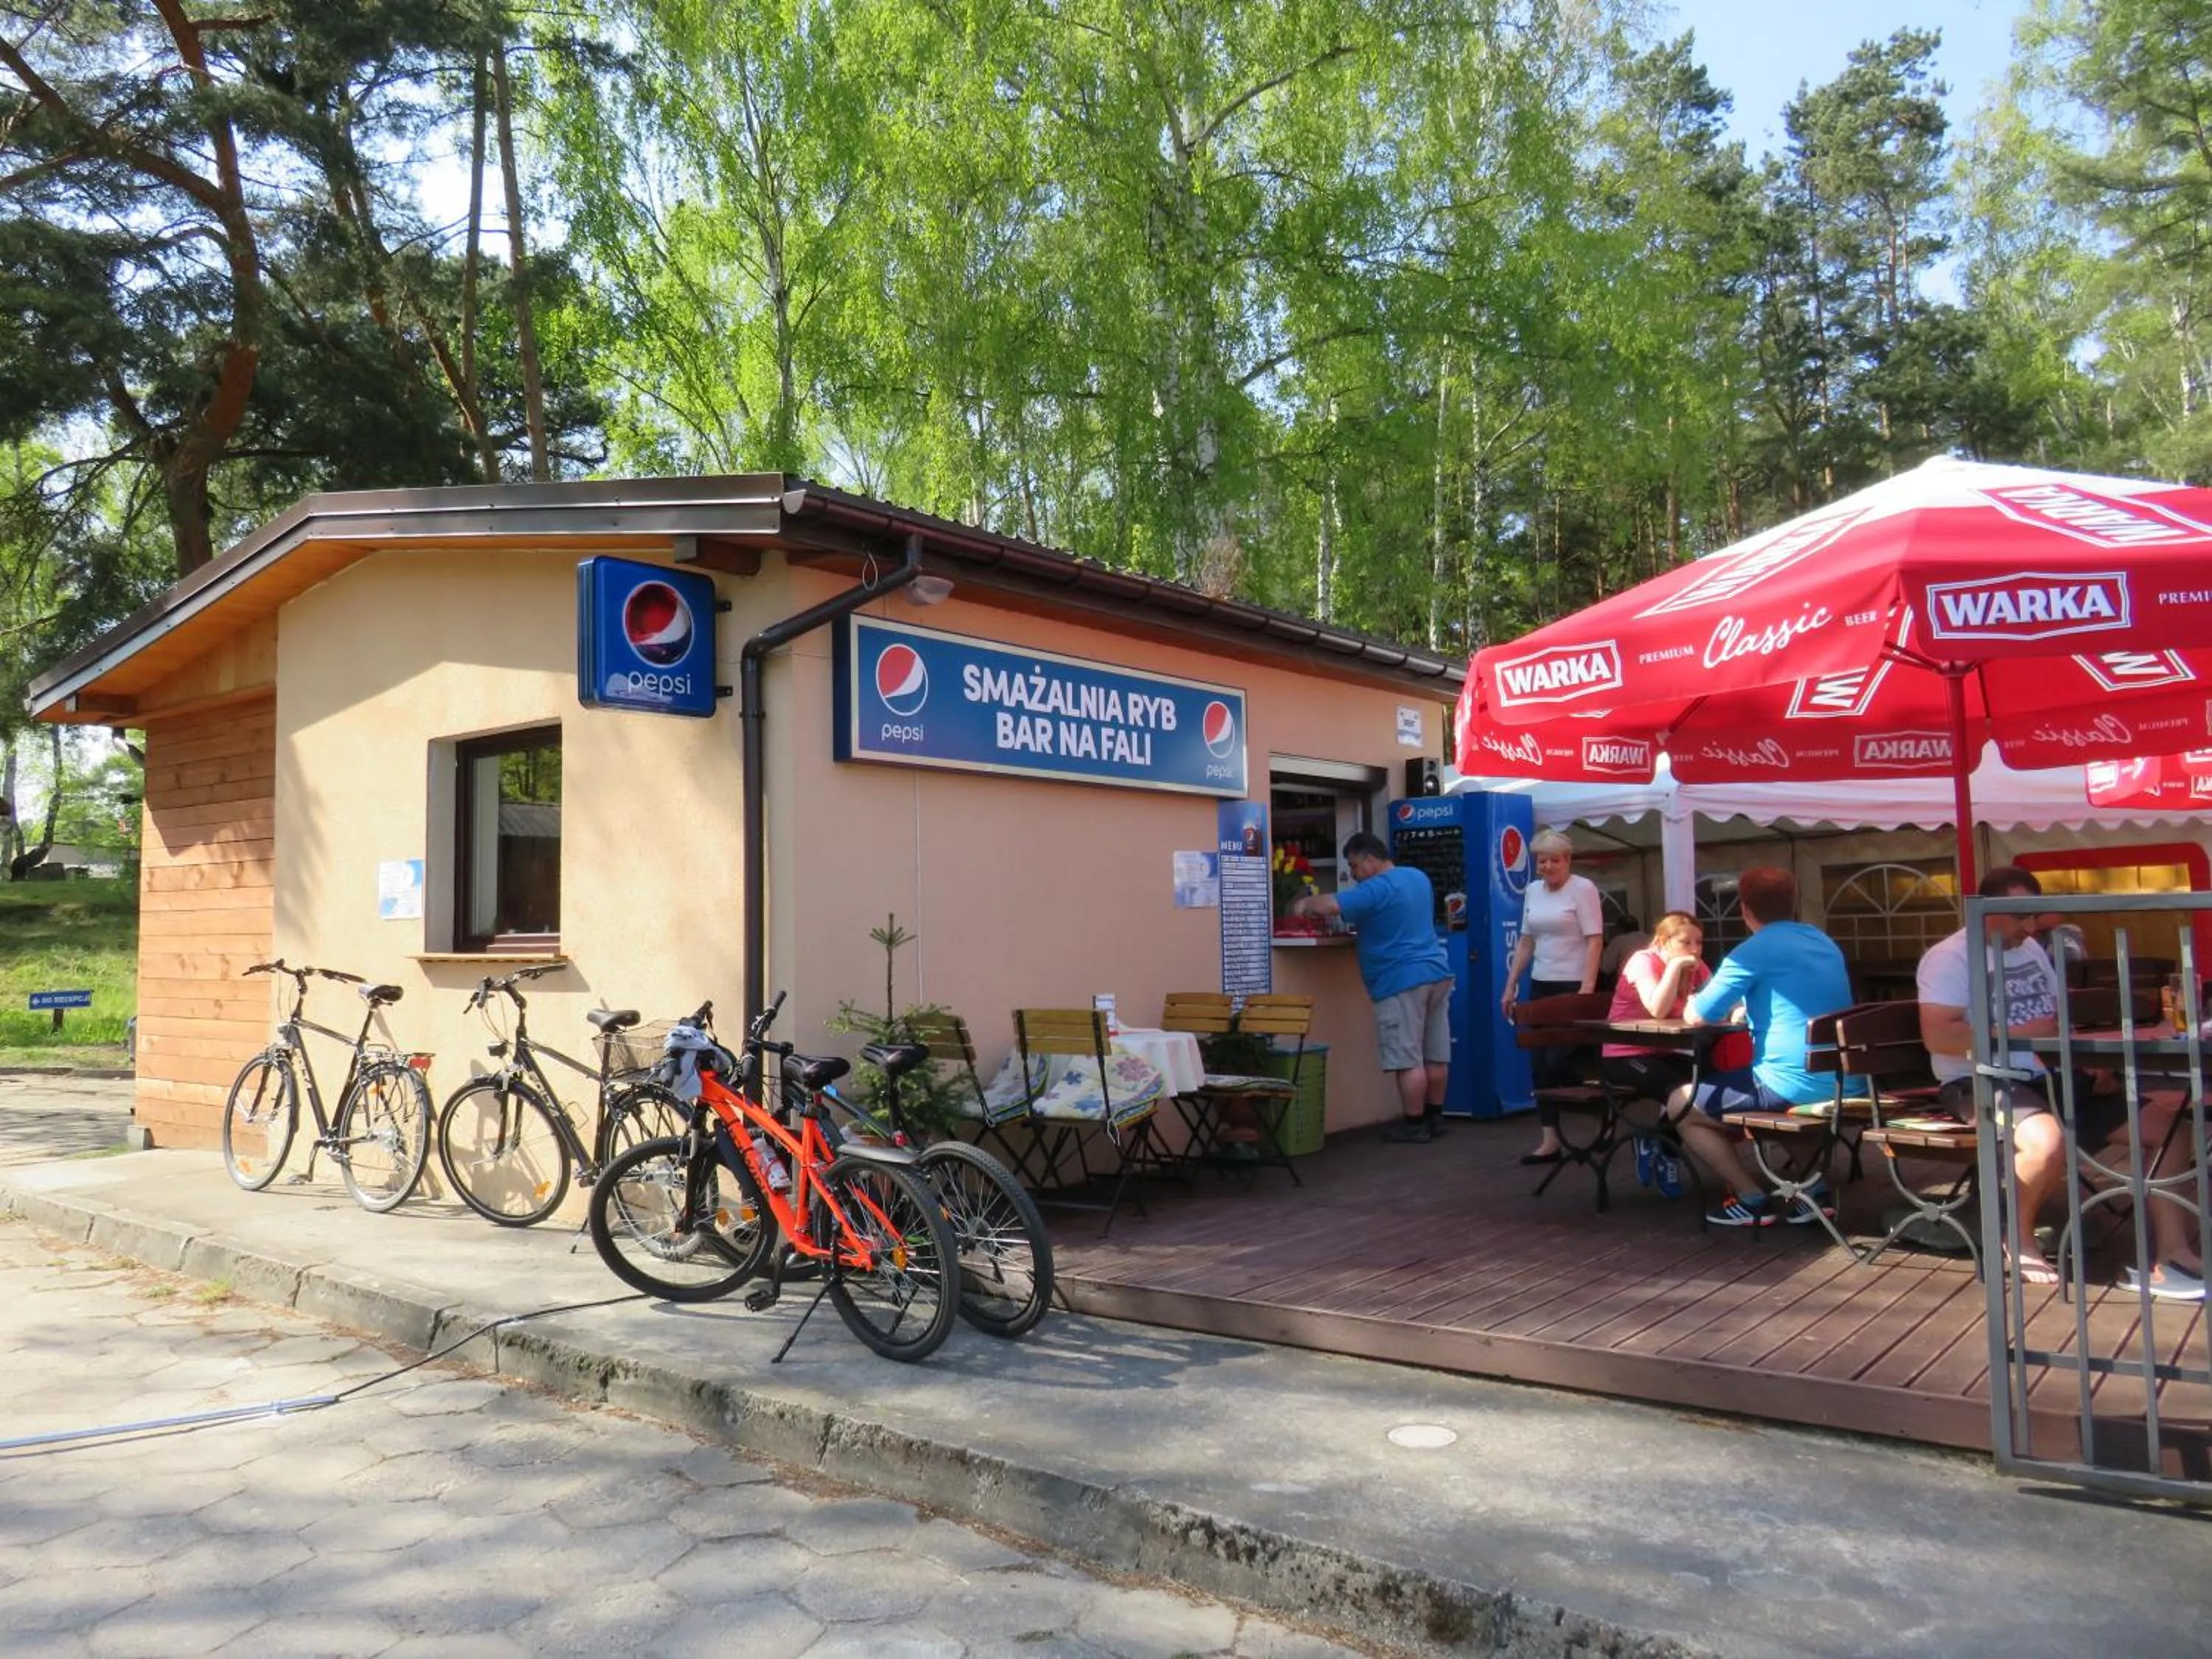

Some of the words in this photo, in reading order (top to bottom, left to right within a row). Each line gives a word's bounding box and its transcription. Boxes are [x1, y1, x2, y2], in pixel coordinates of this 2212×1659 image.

[1997, 486, 2188, 543] WARKA
[1939, 584, 2116, 627] WARKA
[2158, 590, 2212, 605] PREMI
[1503, 653, 1613, 695] WARKA
[1639, 645, 1694, 664] PREMIUM
[1703, 602, 1834, 669] Classic
[1844, 611, 1877, 627] BEER
[628, 671, 691, 698] pepsi
[962, 664, 1124, 723] SMAŻALNIA
[1128, 694, 1178, 731] RYB
[881, 723, 924, 742] pepsi
[996, 712, 1053, 754] BAR
[1060, 722, 1098, 759] NA
[1102, 728, 1151, 766] FALI
[1418, 802, 1453, 821] pepsi
